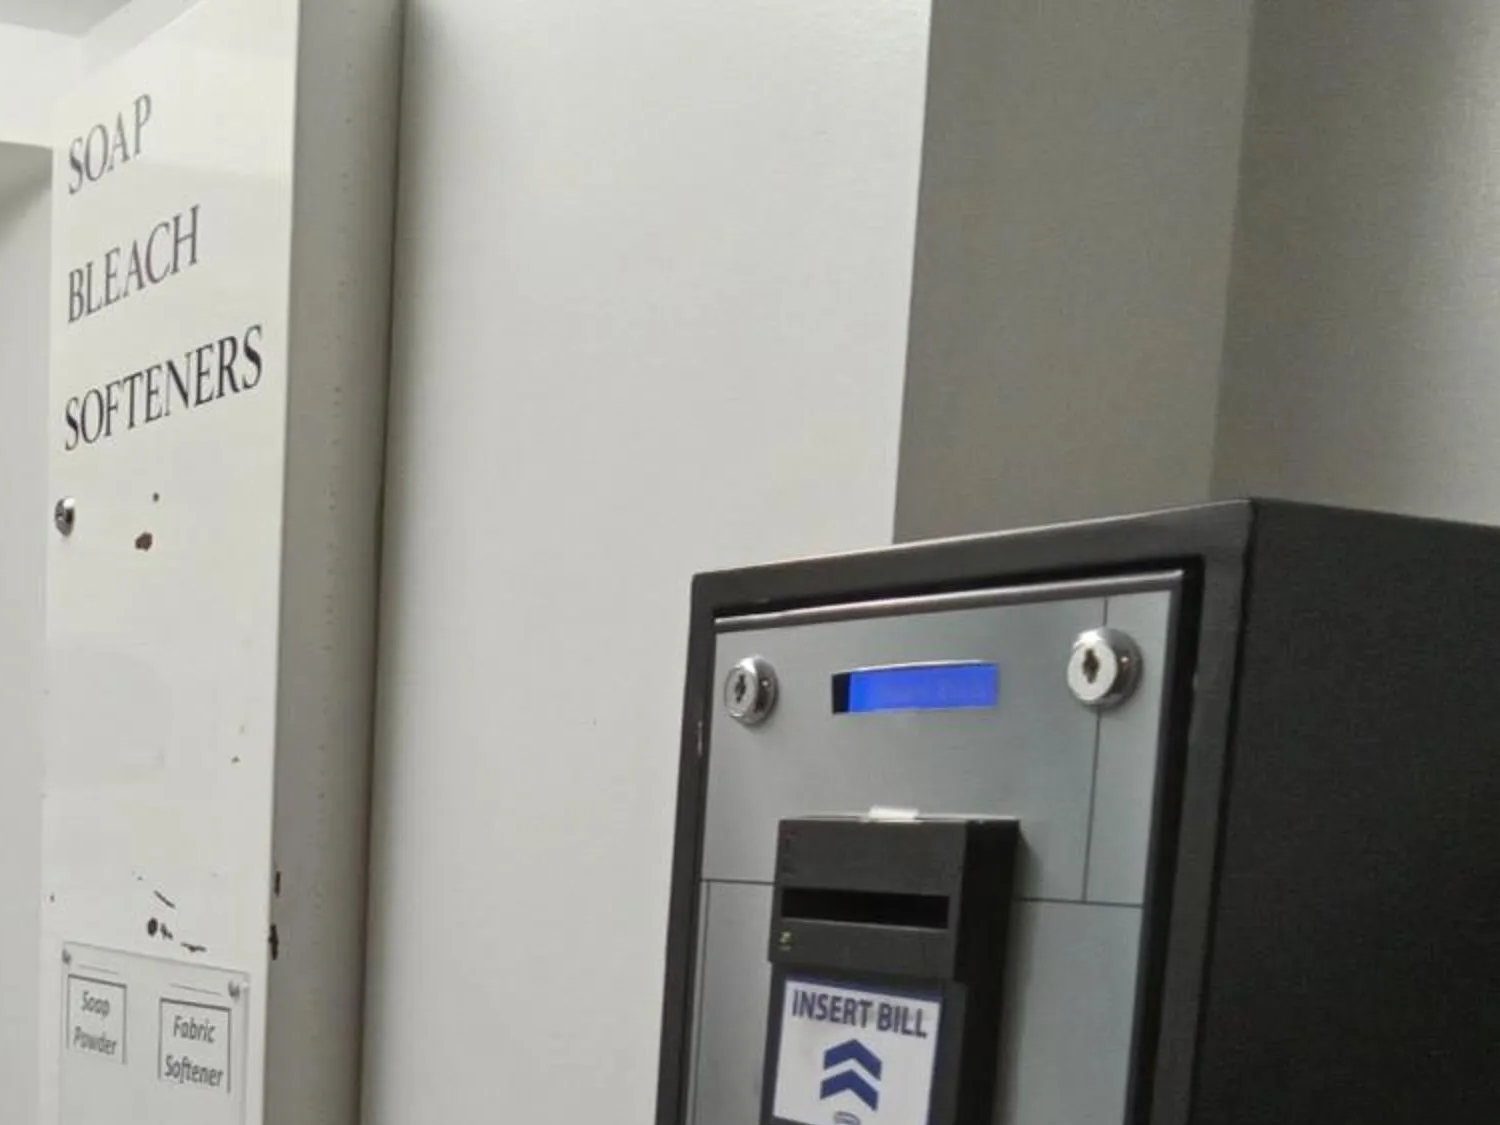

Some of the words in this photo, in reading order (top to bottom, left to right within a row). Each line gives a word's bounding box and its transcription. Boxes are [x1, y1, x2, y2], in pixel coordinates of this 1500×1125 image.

[67, 93, 152, 196] SOAP
[67, 203, 201, 324] BLEACH
[64, 323, 264, 452] SOFTENERS
[80, 988, 111, 1020] Soap
[792, 989, 873, 1029] INSERT
[876, 1002, 928, 1039] BILL
[72, 1025, 118, 1056] Powder
[172, 1014, 216, 1044] Fabric
[164, 1053, 224, 1087] Softener
